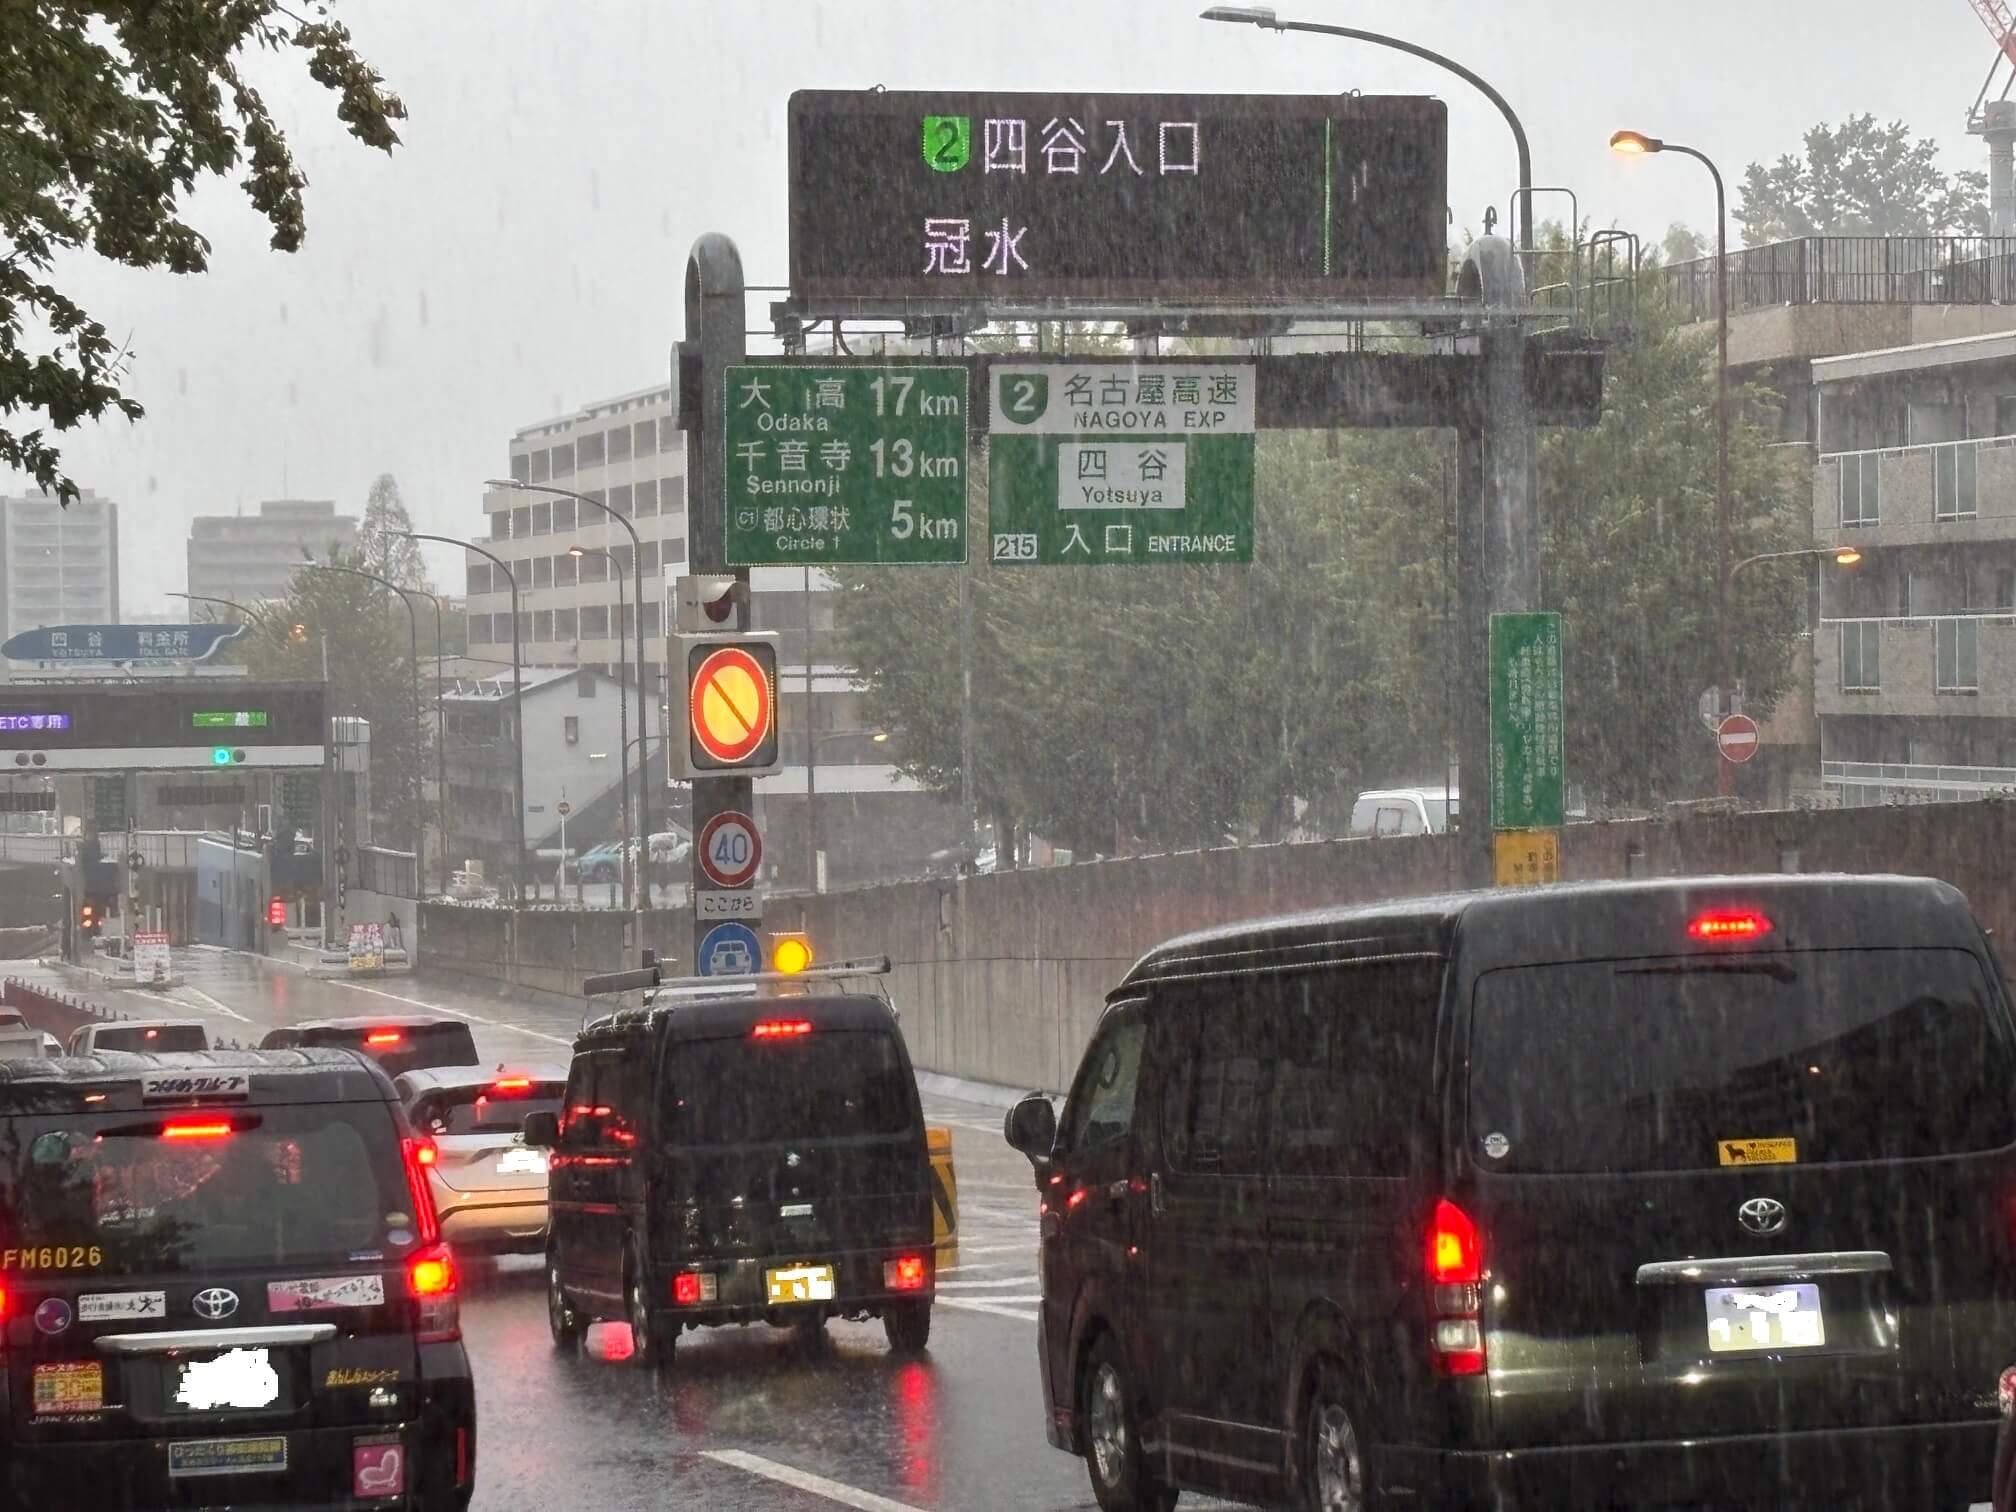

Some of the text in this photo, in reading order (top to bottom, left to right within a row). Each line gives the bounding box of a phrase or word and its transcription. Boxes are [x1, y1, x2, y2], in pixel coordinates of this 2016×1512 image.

[984, 117, 1201, 176] 四谷入口
[923, 216, 1029, 275] 冠水
[740, 375, 959, 417] 大高 17 km
[1013, 373, 1238, 412] 2 名古屋高速
[757, 412, 829, 432] Odaka
[1073, 410, 1227, 429] NAGOYA EXP
[736, 438, 959, 478] 千音寺 13 km
[1078, 448, 1168, 481] 四谷
[746, 475, 840, 497] Sennonji
[1081, 486, 1163, 507] Yotsuya
[891, 500, 914, 539] 5
[920, 513, 958, 539] km
[776, 535, 825, 551] Circle
[997, 523, 1236, 558] 215 入口 ENTRANCE
[51, 631, 103, 647] 四谷
[714, 832, 748, 865] 40
[703, 896, 754, 913] ここから
[2, 1246, 102, 1270] FM6026
